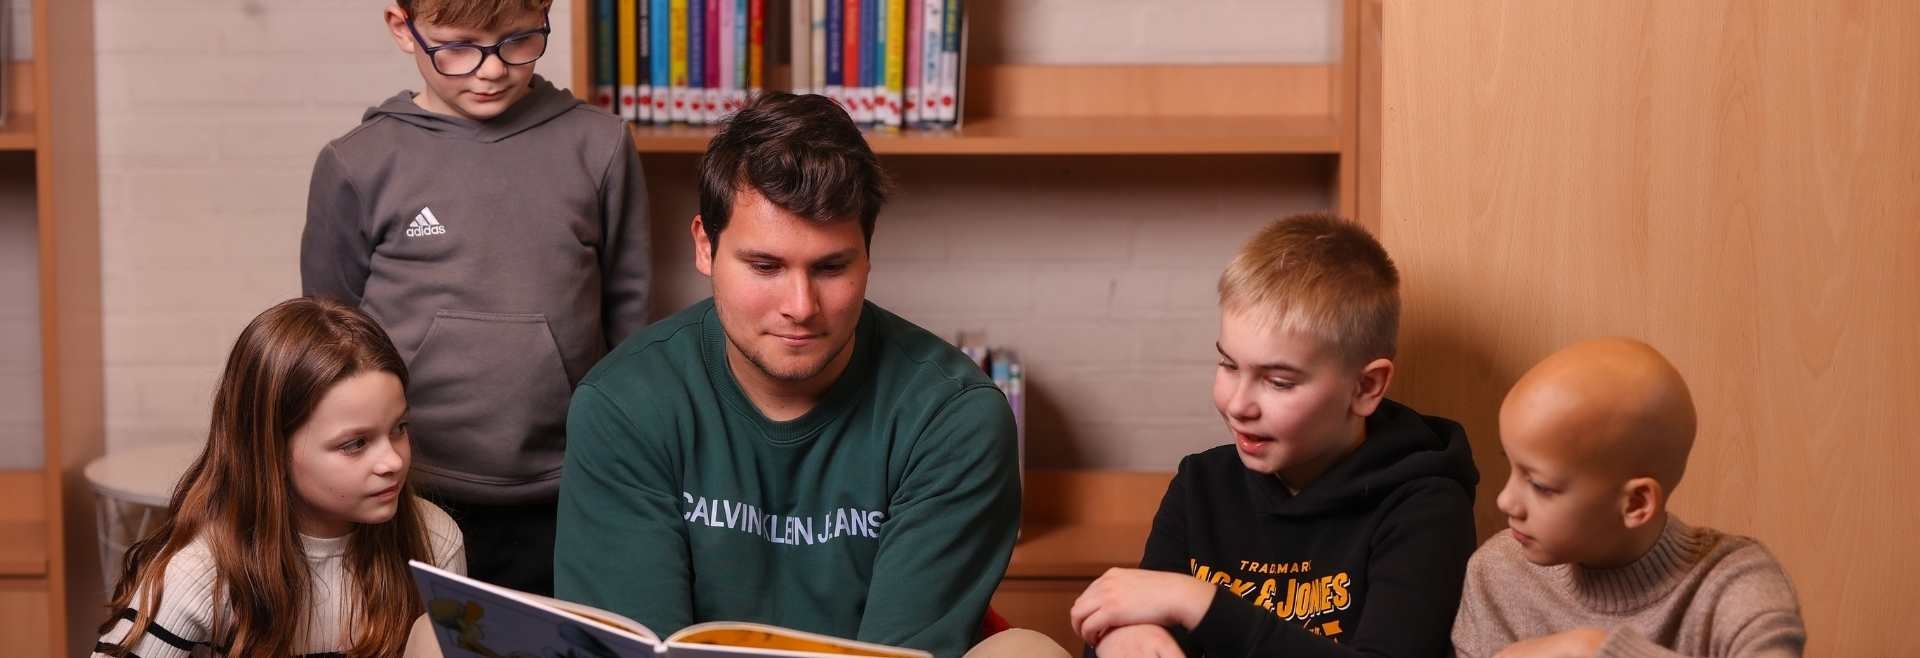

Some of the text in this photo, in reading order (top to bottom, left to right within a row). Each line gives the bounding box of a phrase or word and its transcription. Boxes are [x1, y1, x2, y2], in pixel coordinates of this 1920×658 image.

[406, 225, 446, 237] adidas
[682, 491, 761, 536] CALVIN
[817, 507, 885, 544] JANS
[1276, 571, 1351, 621] JONES
